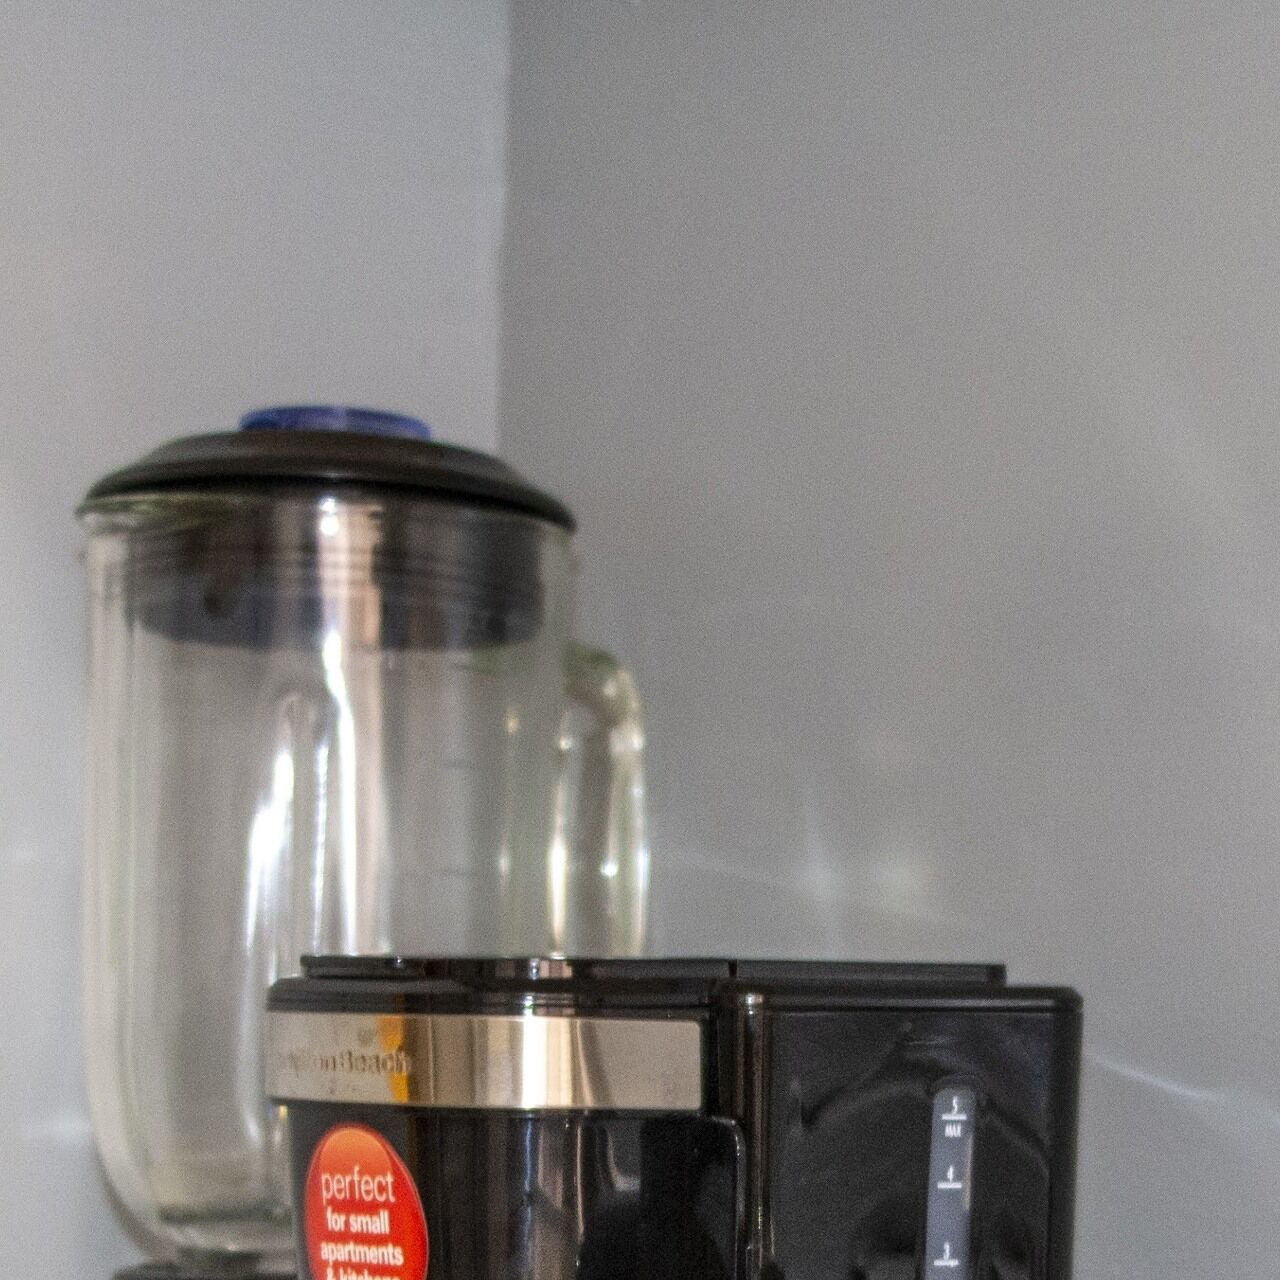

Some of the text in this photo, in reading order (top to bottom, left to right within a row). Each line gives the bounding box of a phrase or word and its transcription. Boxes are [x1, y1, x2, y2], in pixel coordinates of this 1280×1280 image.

[321, 1165, 396, 1204] perfect
[326, 1206, 390, 1235] for small
[320, 1240, 405, 1268] apartments
